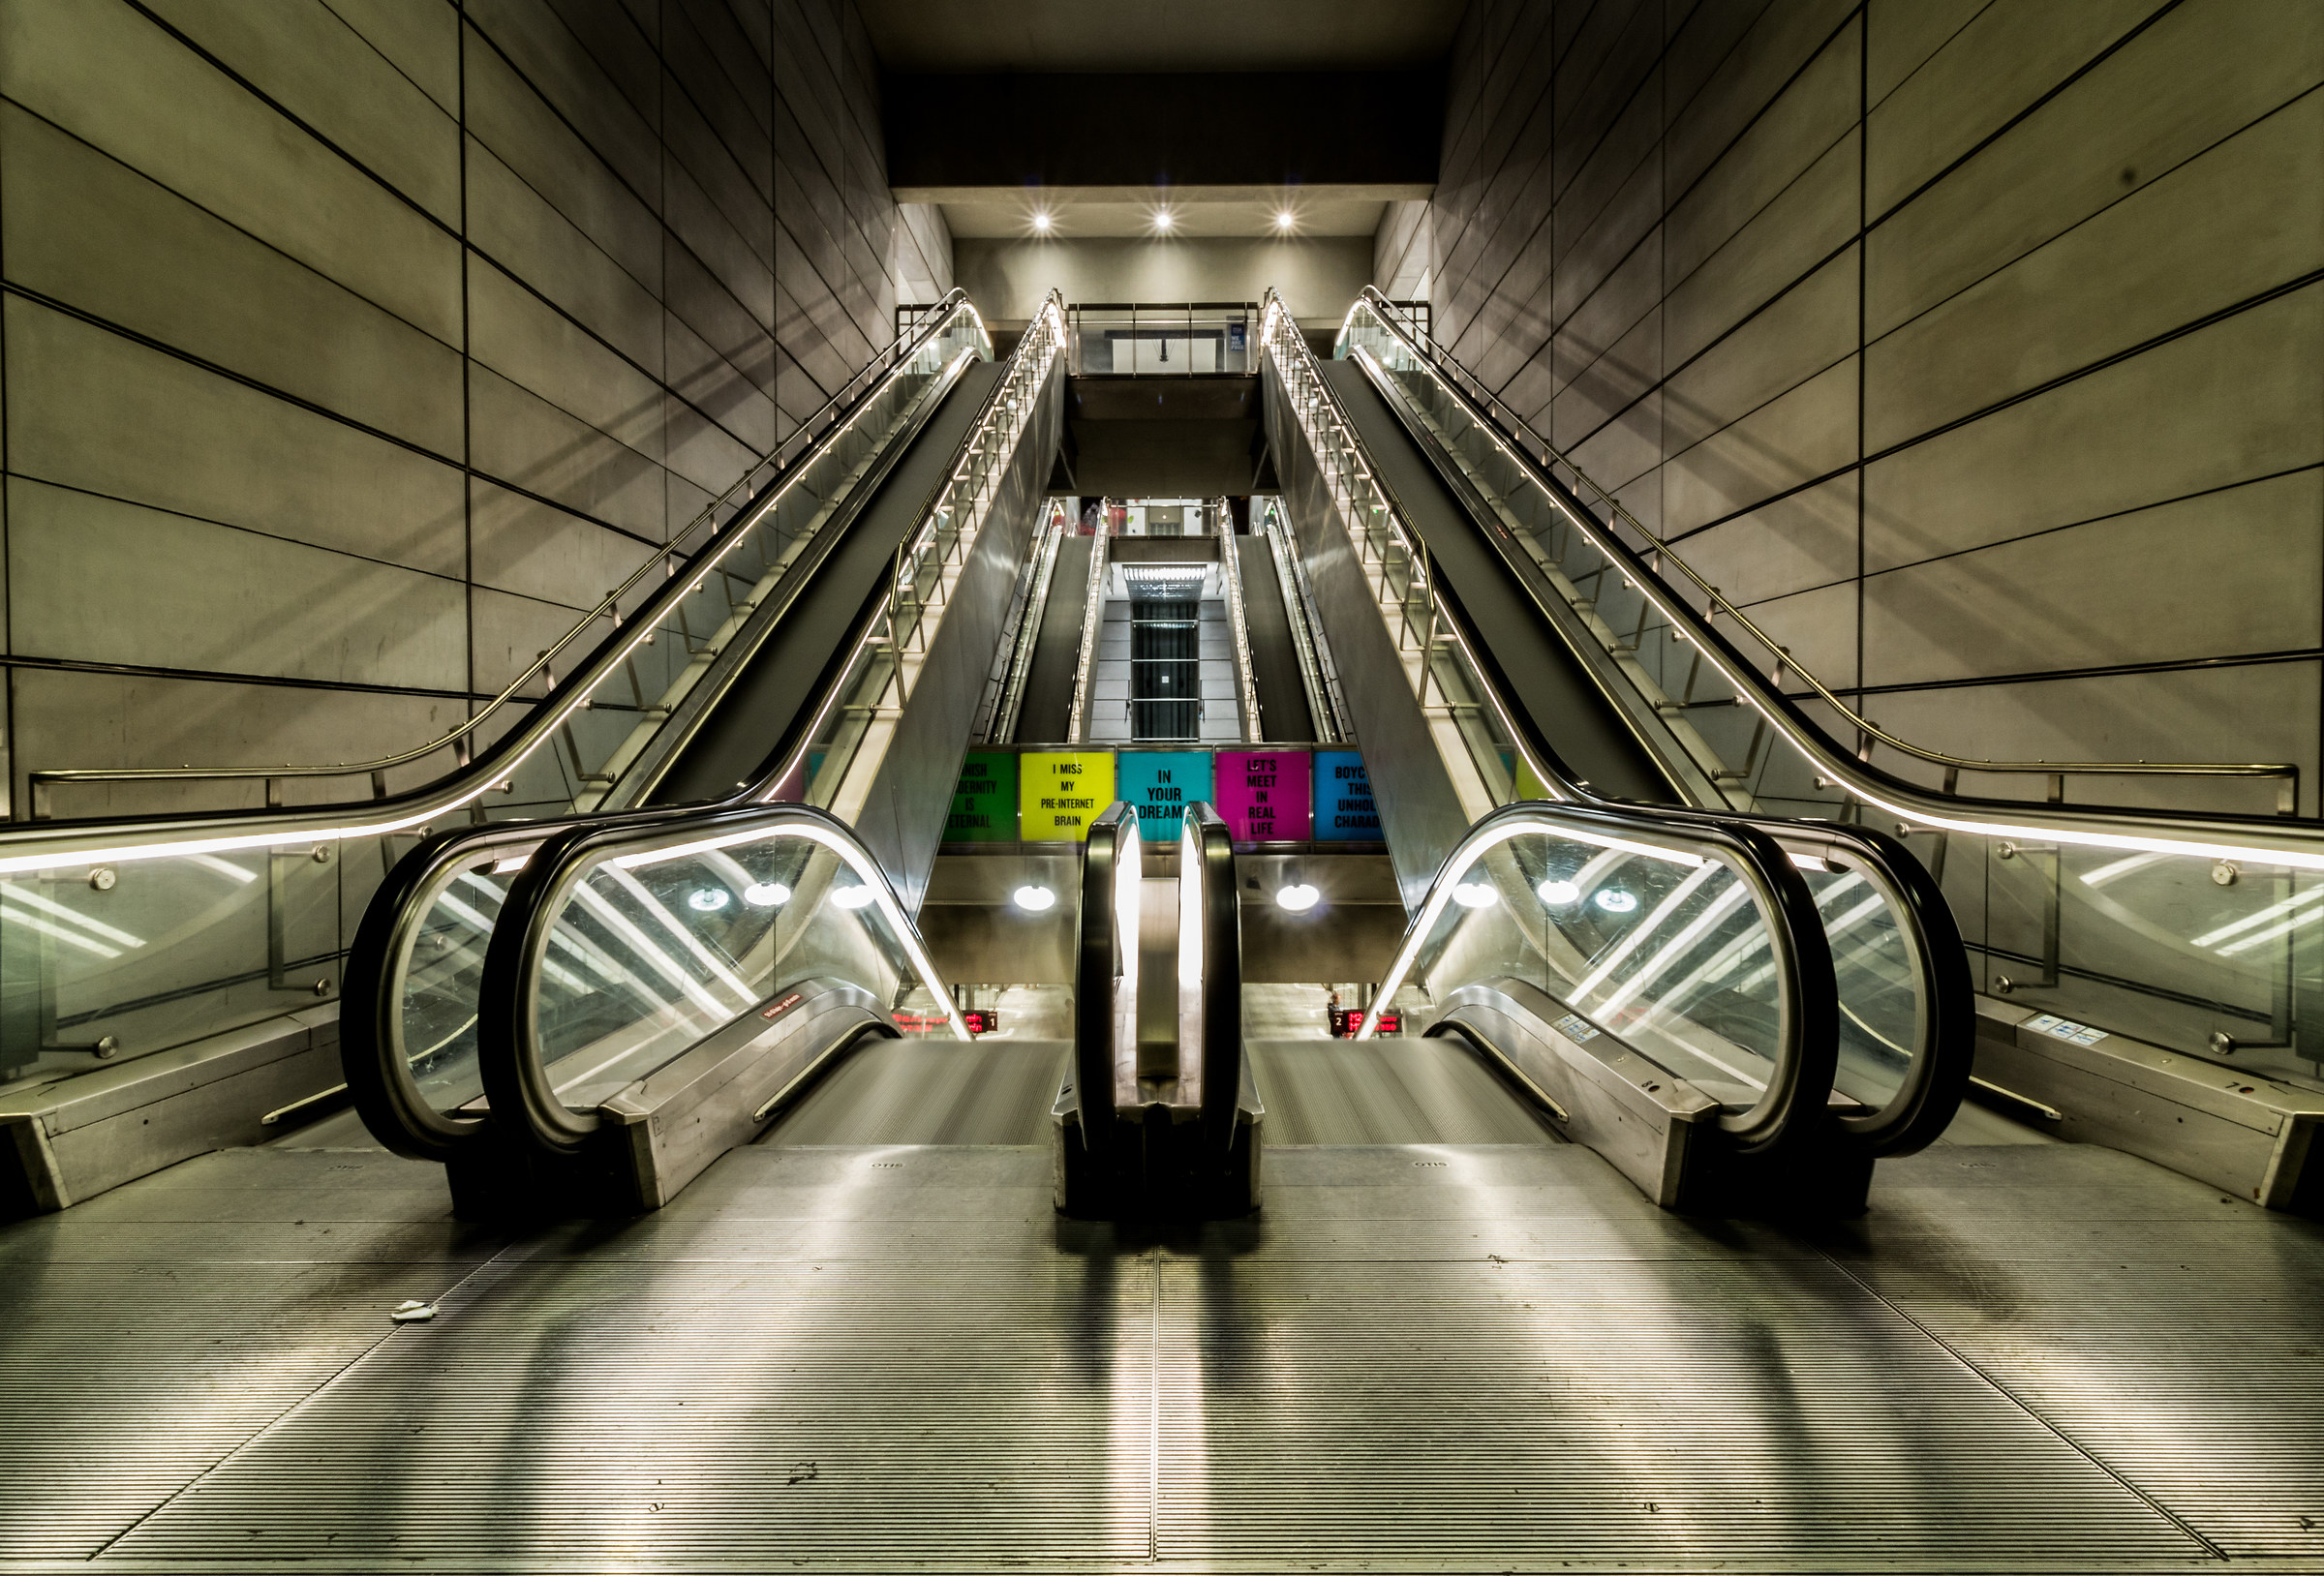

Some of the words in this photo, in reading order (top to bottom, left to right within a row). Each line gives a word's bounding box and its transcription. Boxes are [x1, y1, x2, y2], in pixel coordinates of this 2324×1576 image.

[1053, 764, 1056, 774] I
[1060, 764, 1083, 774] MISS
[1247, 759, 1276, 772] LET'S
[1158, 770, 1171, 783] IN
[1247, 775, 1276, 787] MEET
[956, 780, 997, 794] DERNITY
[1061, 781, 1075, 791] MY
[1147, 787, 1181, 802] YOUR
[1256, 791, 1268, 803] IN
[965, 797, 974, 811] IS
[1041, 799, 1094, 809] PRE-INTERNET
[1139, 804, 1185, 819] DREAM
[1249, 806, 1275, 819] REAL
[1055, 816, 1082, 826] BRAIN
[1251, 822, 1273, 834] LIFE
[1335, 1017, 1342, 1026] 2
